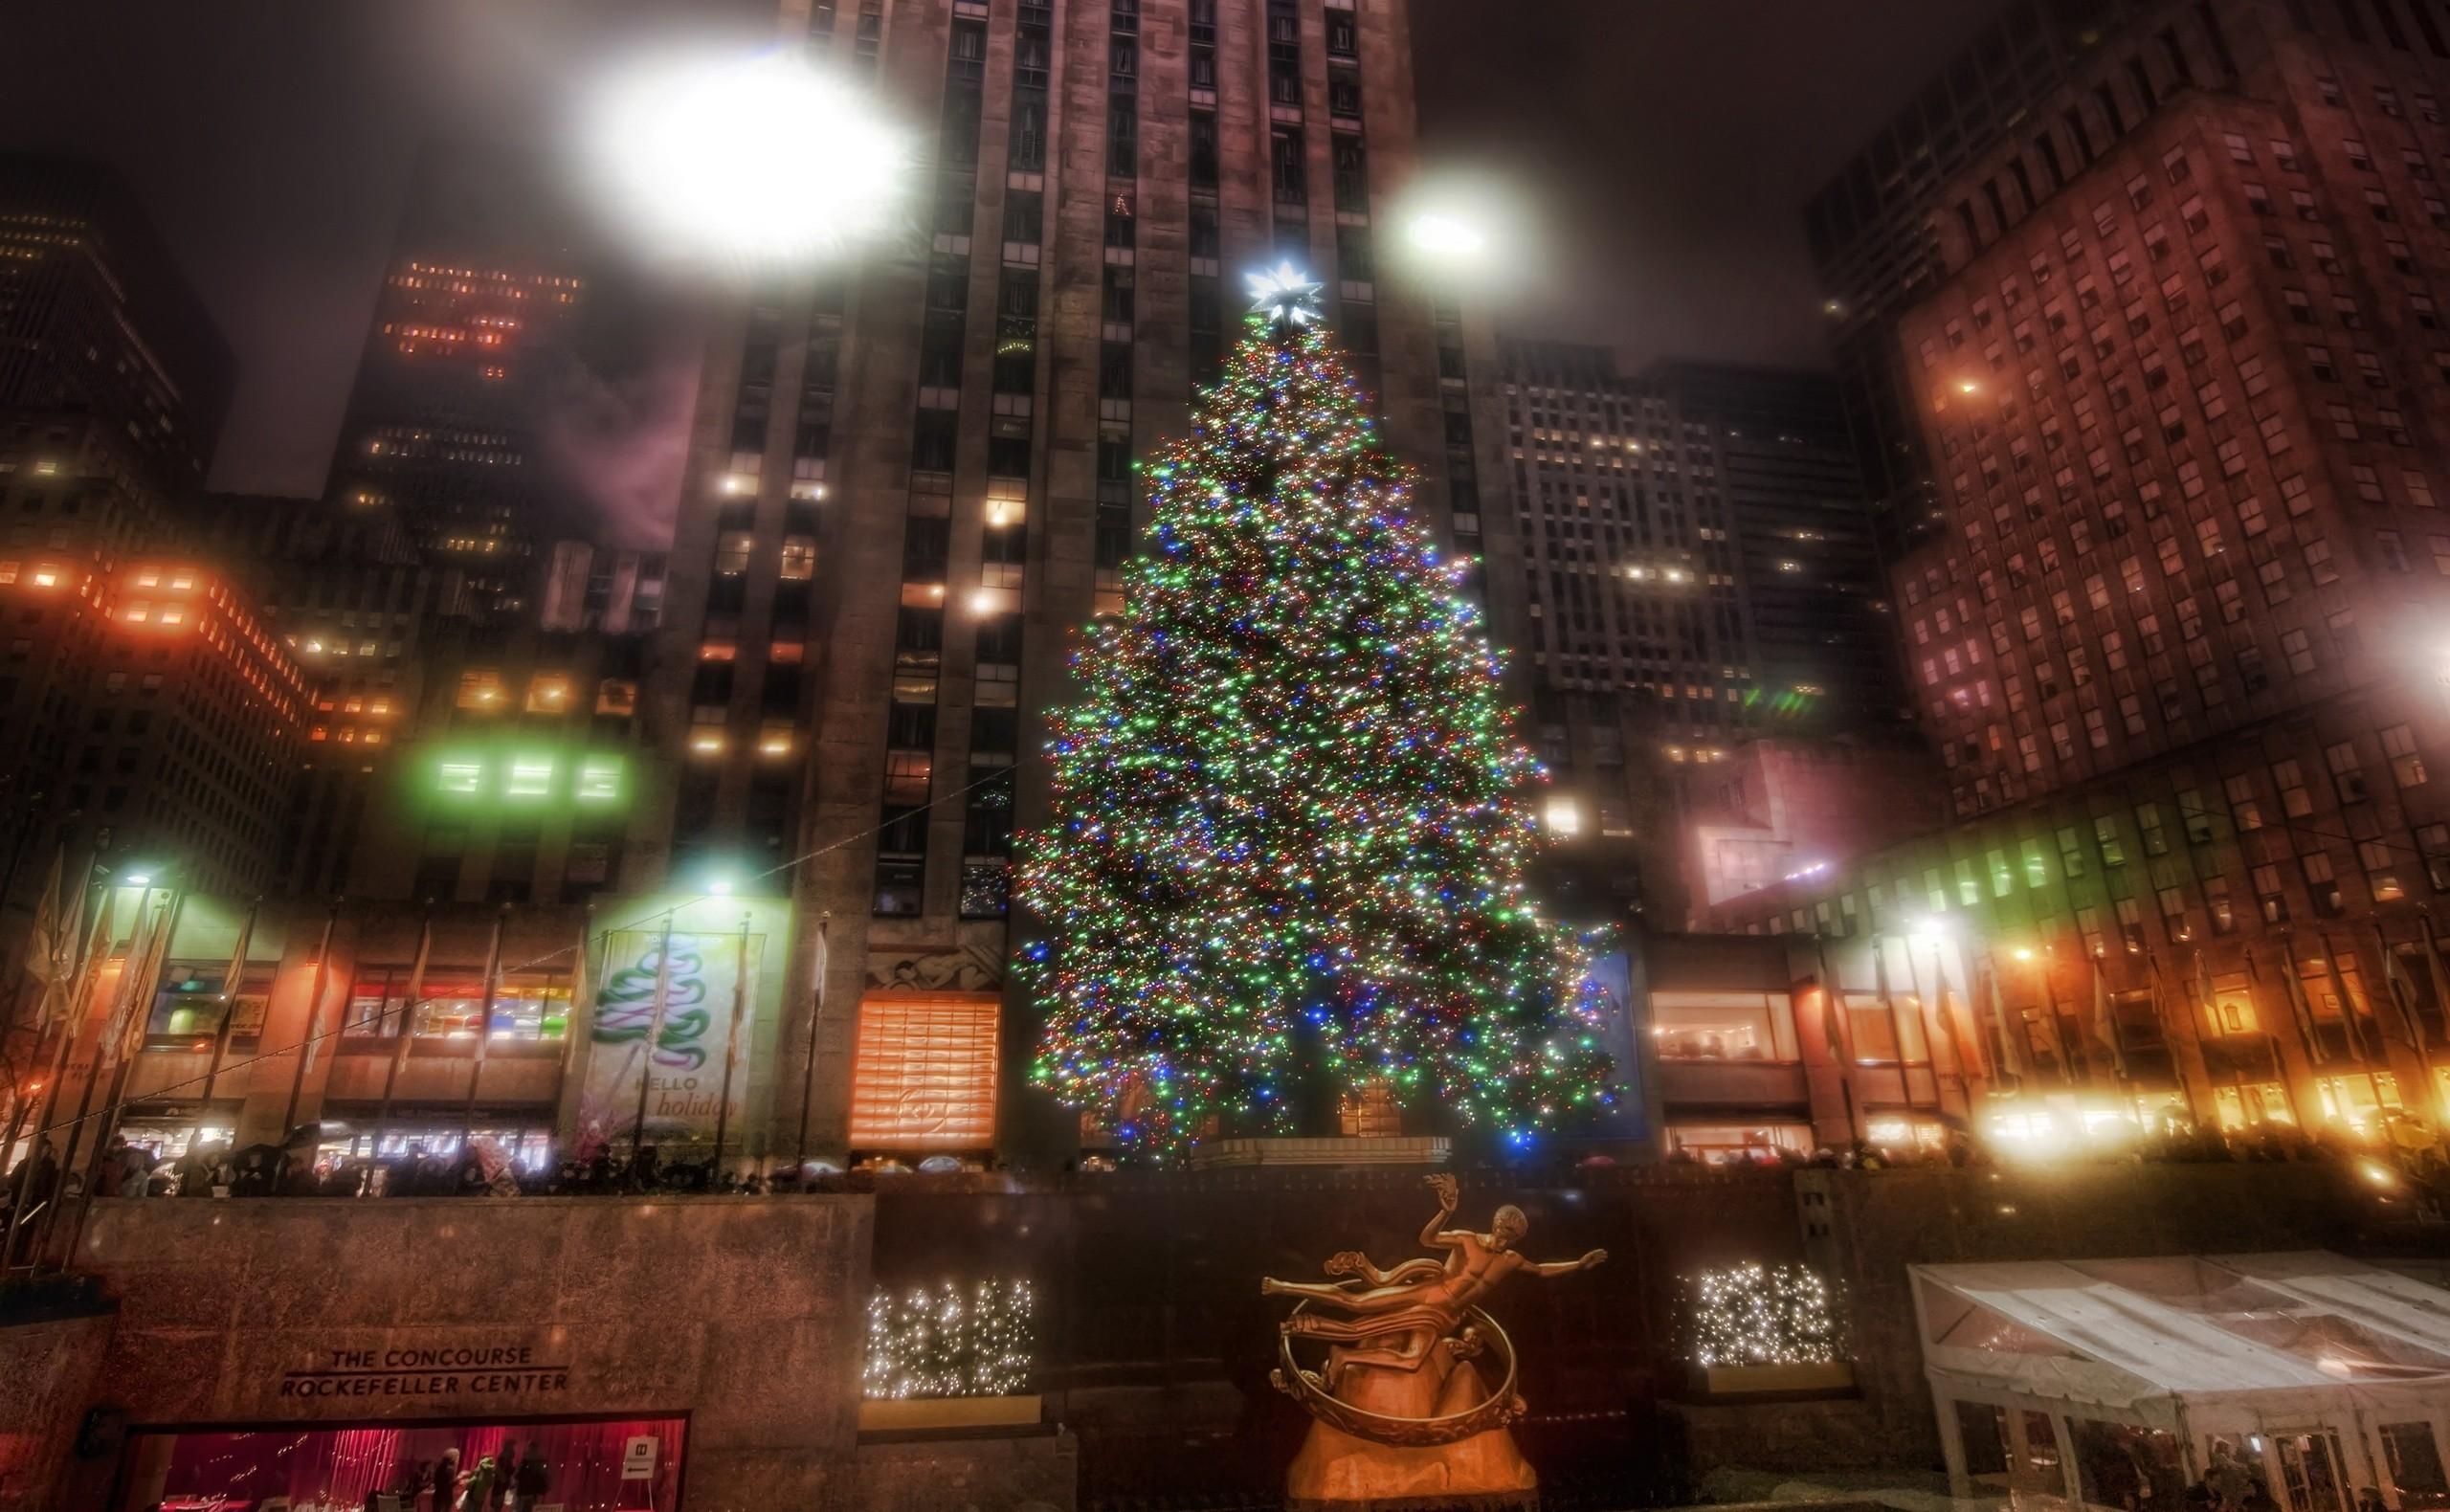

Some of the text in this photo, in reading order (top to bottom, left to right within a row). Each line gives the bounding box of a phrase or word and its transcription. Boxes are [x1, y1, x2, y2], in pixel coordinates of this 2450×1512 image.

[333, 1347, 532, 1367] THE CONCOURSE
[280, 1373, 568, 1397] ROCKEFELLER CENTER
